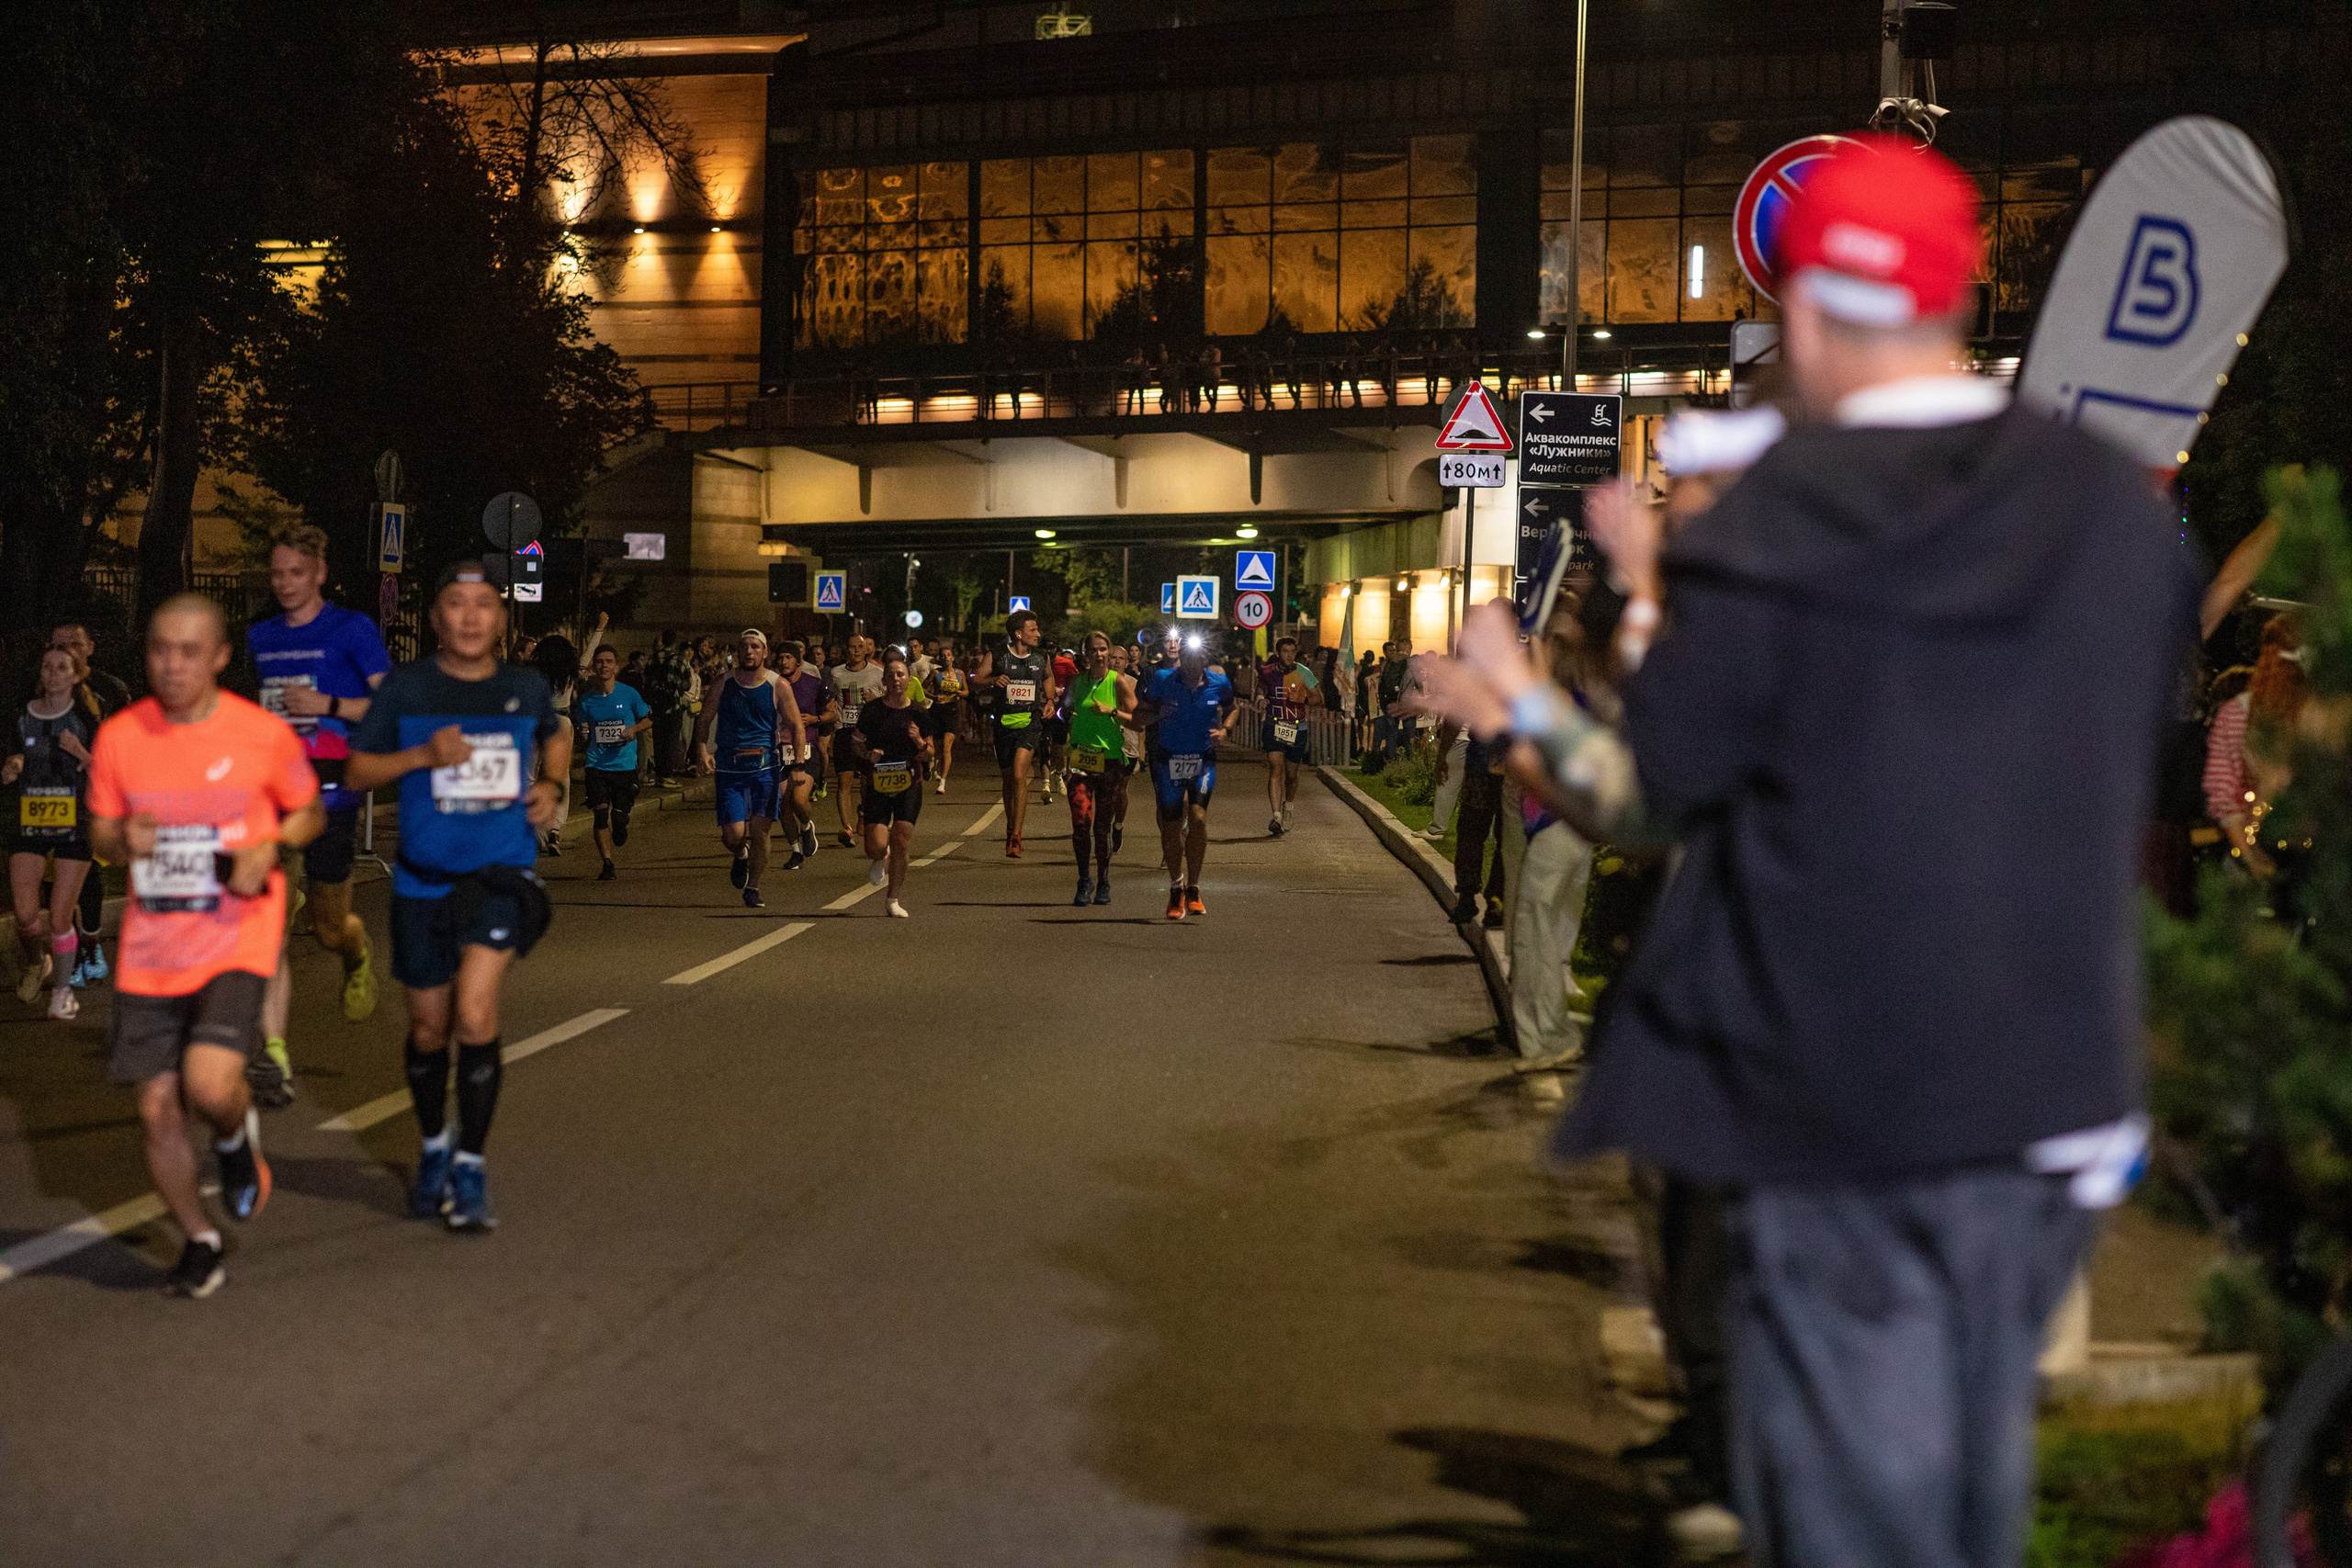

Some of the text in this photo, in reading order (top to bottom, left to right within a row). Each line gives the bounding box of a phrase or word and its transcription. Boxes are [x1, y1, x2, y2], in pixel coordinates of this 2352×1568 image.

[1525, 432, 1617, 446] Аквакомплекс
[1529, 445, 1612, 459] «Лужники»
[1529, 463, 1611, 475] Aquatic Center
[1244, 603, 1262, 617] 10
[1011, 688, 1031, 697] 9821
[845, 711, 860, 719] 739
[599, 728, 622, 738] 7323
[1278, 728, 1294, 738] 1851
[878, 774, 907, 787] 7738
[28, 801, 69, 817] 8973
